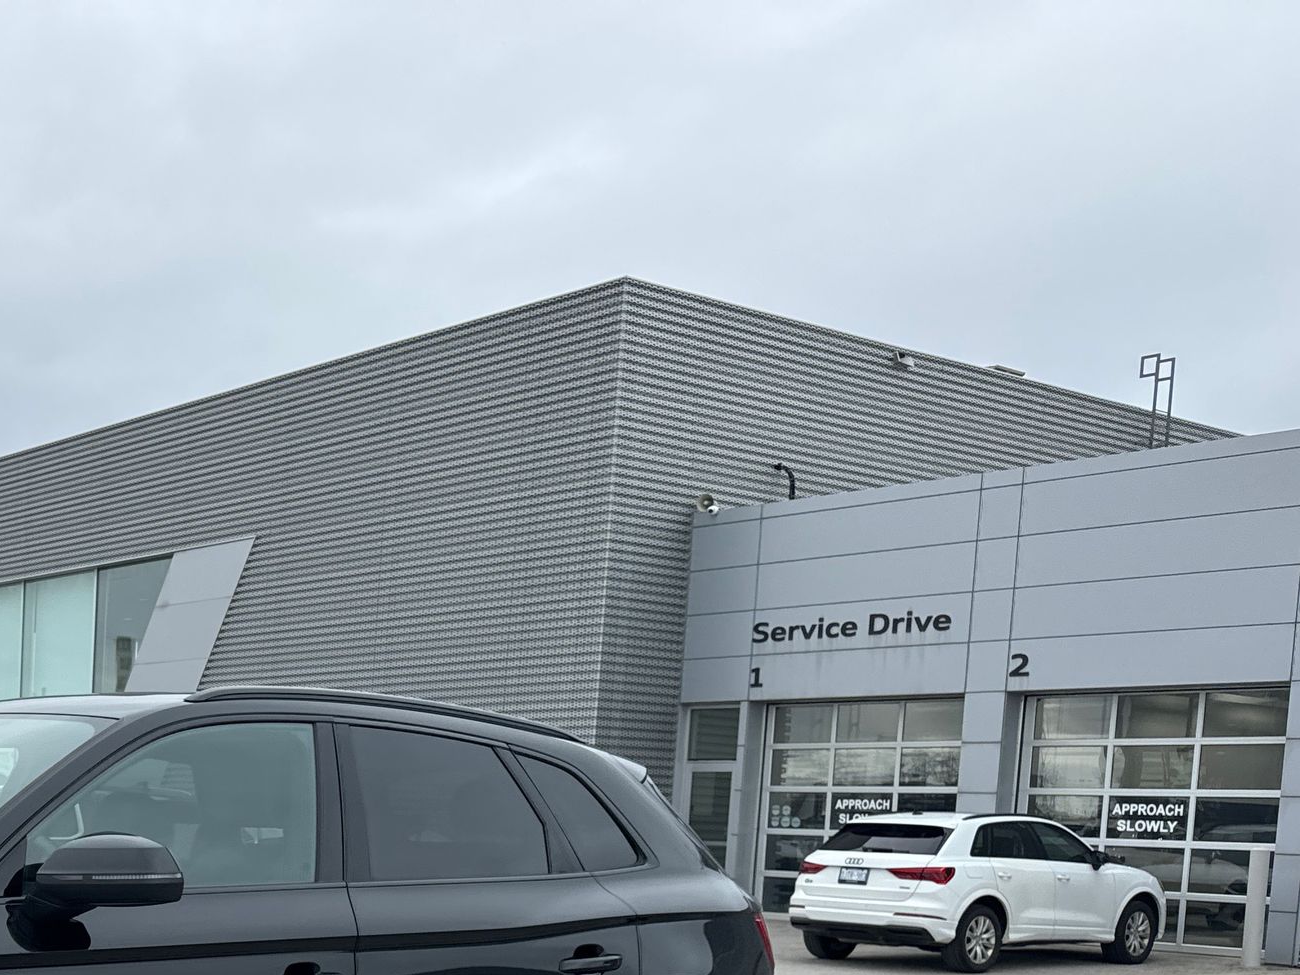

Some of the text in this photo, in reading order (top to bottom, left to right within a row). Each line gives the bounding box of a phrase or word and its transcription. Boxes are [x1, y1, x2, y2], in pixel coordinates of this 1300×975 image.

[752, 610, 952, 644] Service Drive
[1008, 653, 1030, 677] 2
[750, 667, 763, 688] 1
[834, 799, 890, 810] APPROACH
[1112, 803, 1184, 816] APPROACH
[1116, 819, 1178, 833] SLOWLY
